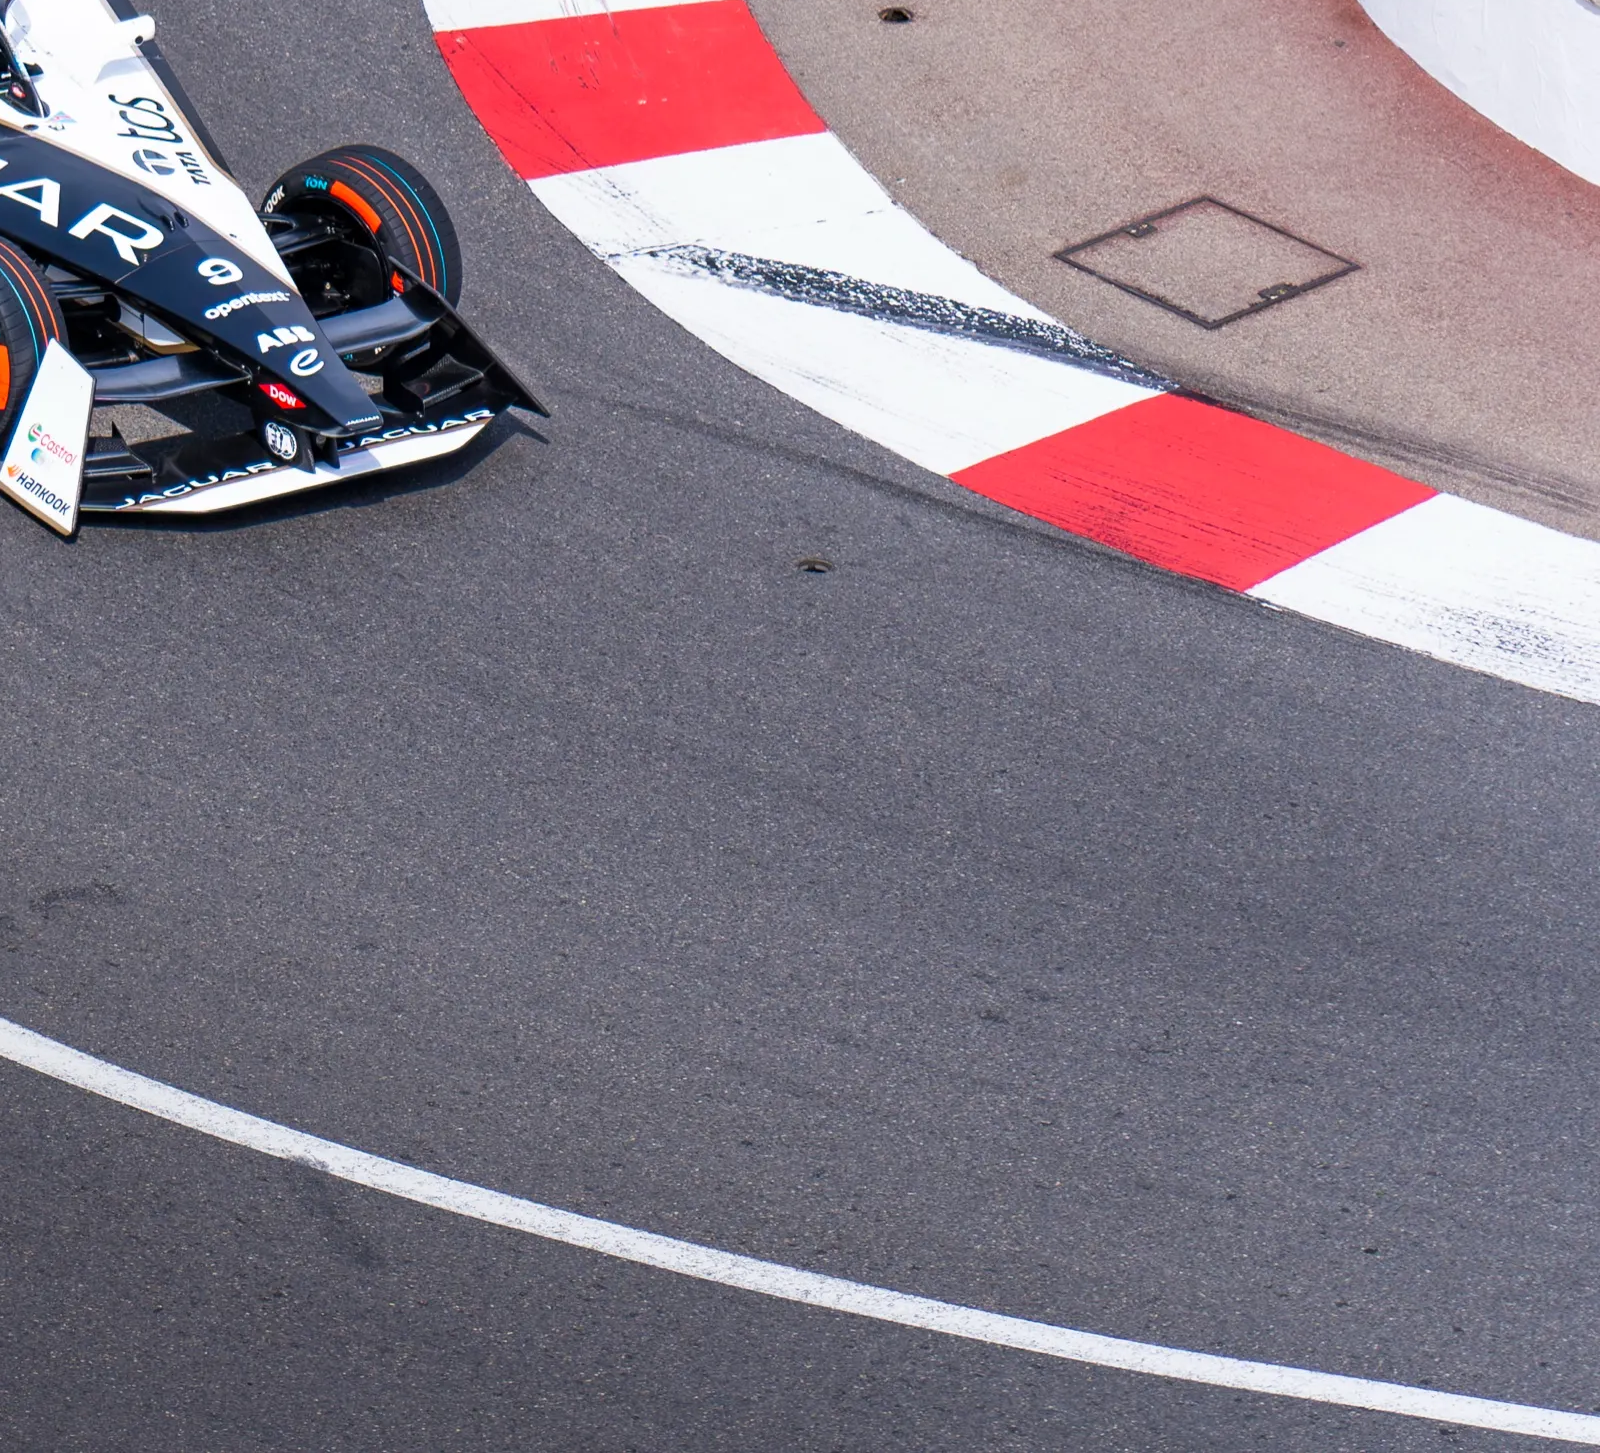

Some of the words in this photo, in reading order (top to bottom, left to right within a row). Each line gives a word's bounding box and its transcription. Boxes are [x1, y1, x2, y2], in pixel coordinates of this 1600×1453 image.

[108, 94, 184, 144] tcs
[175, 151, 211, 185] TATA
[198, 258, 243, 285] 9
[205, 291, 290, 320] opentext
[257, 326, 315, 354] ABB
[267, 426, 297, 458] FIA
[337, 409, 495, 452] JAGUAR
[40, 433, 78, 466] Castrol
[115, 461, 277, 509] JAGUAR
